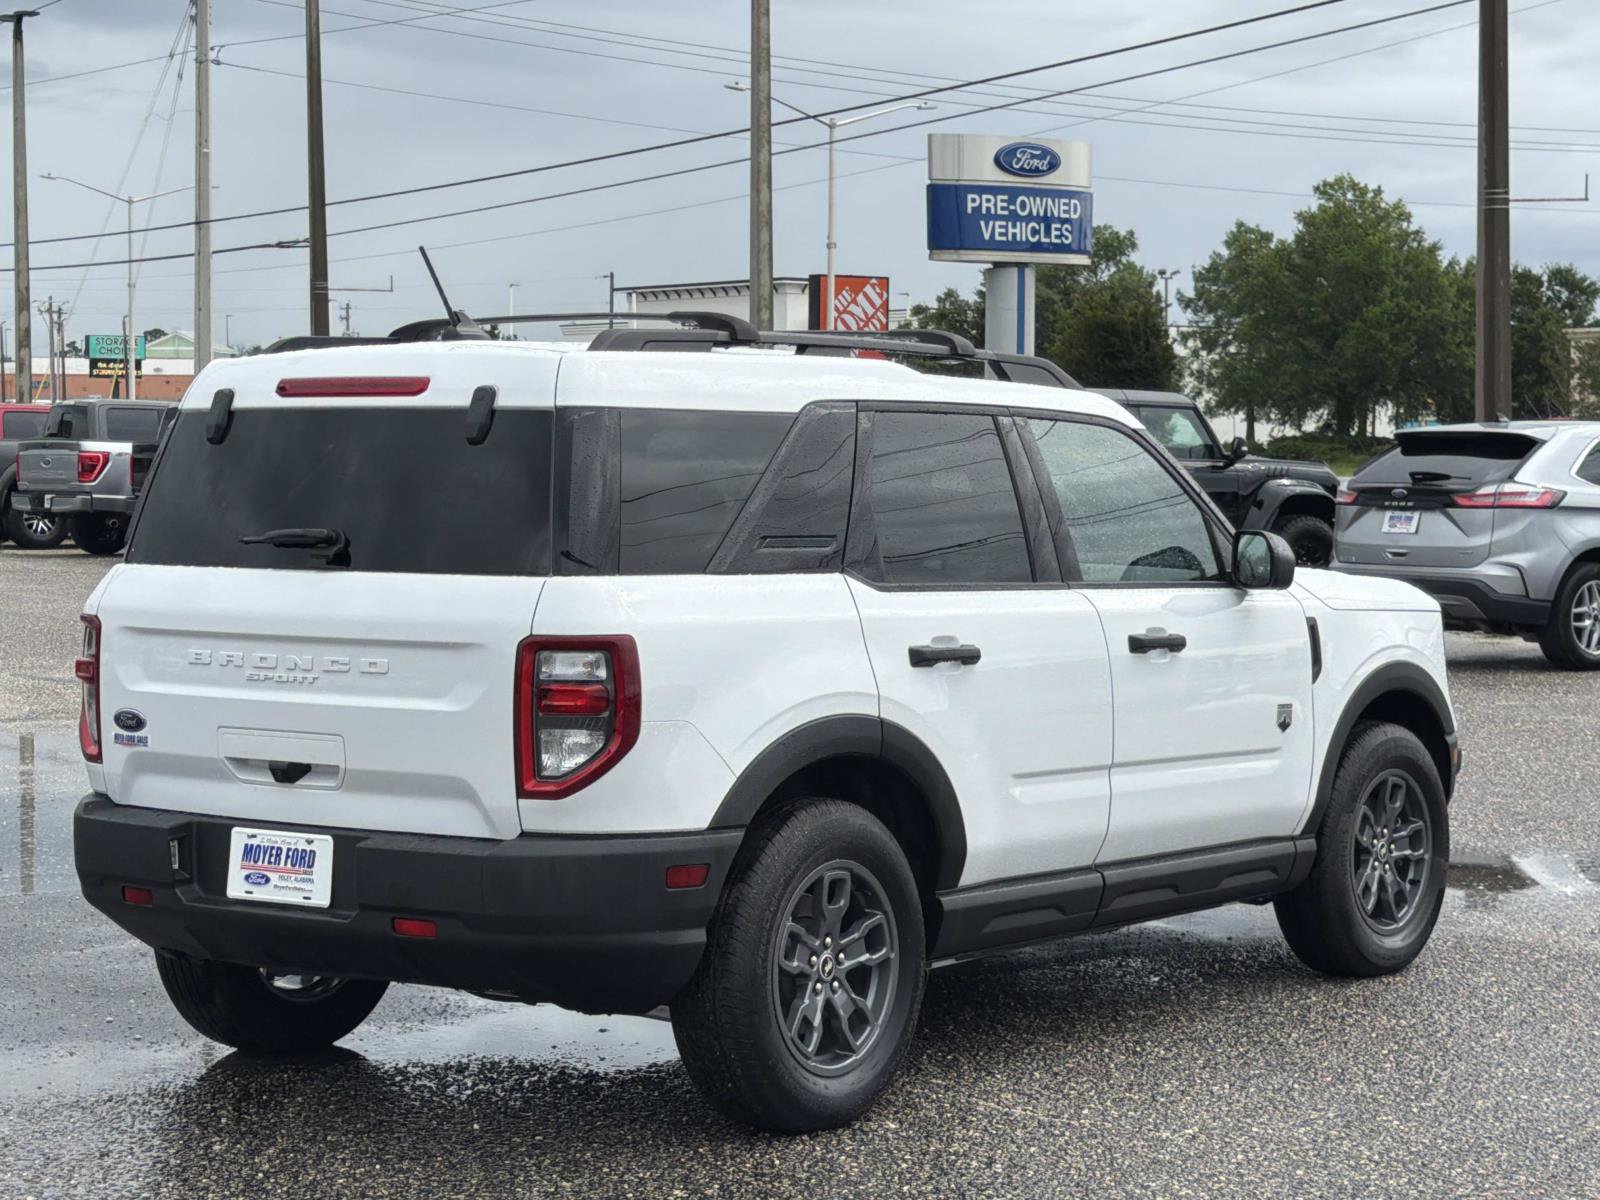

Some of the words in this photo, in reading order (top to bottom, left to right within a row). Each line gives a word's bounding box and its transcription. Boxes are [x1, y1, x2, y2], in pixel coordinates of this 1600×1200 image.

[1012, 148, 1051, 171] Ford
[966, 193, 1082, 220] PRE-OWNED
[979, 220, 1073, 245] VEHICLES
[188, 648, 390, 675] BRONCO
[245, 672, 320, 684] SPORT
[241, 843, 282, 865] MOYER
[284, 847, 316, 869] FORD
